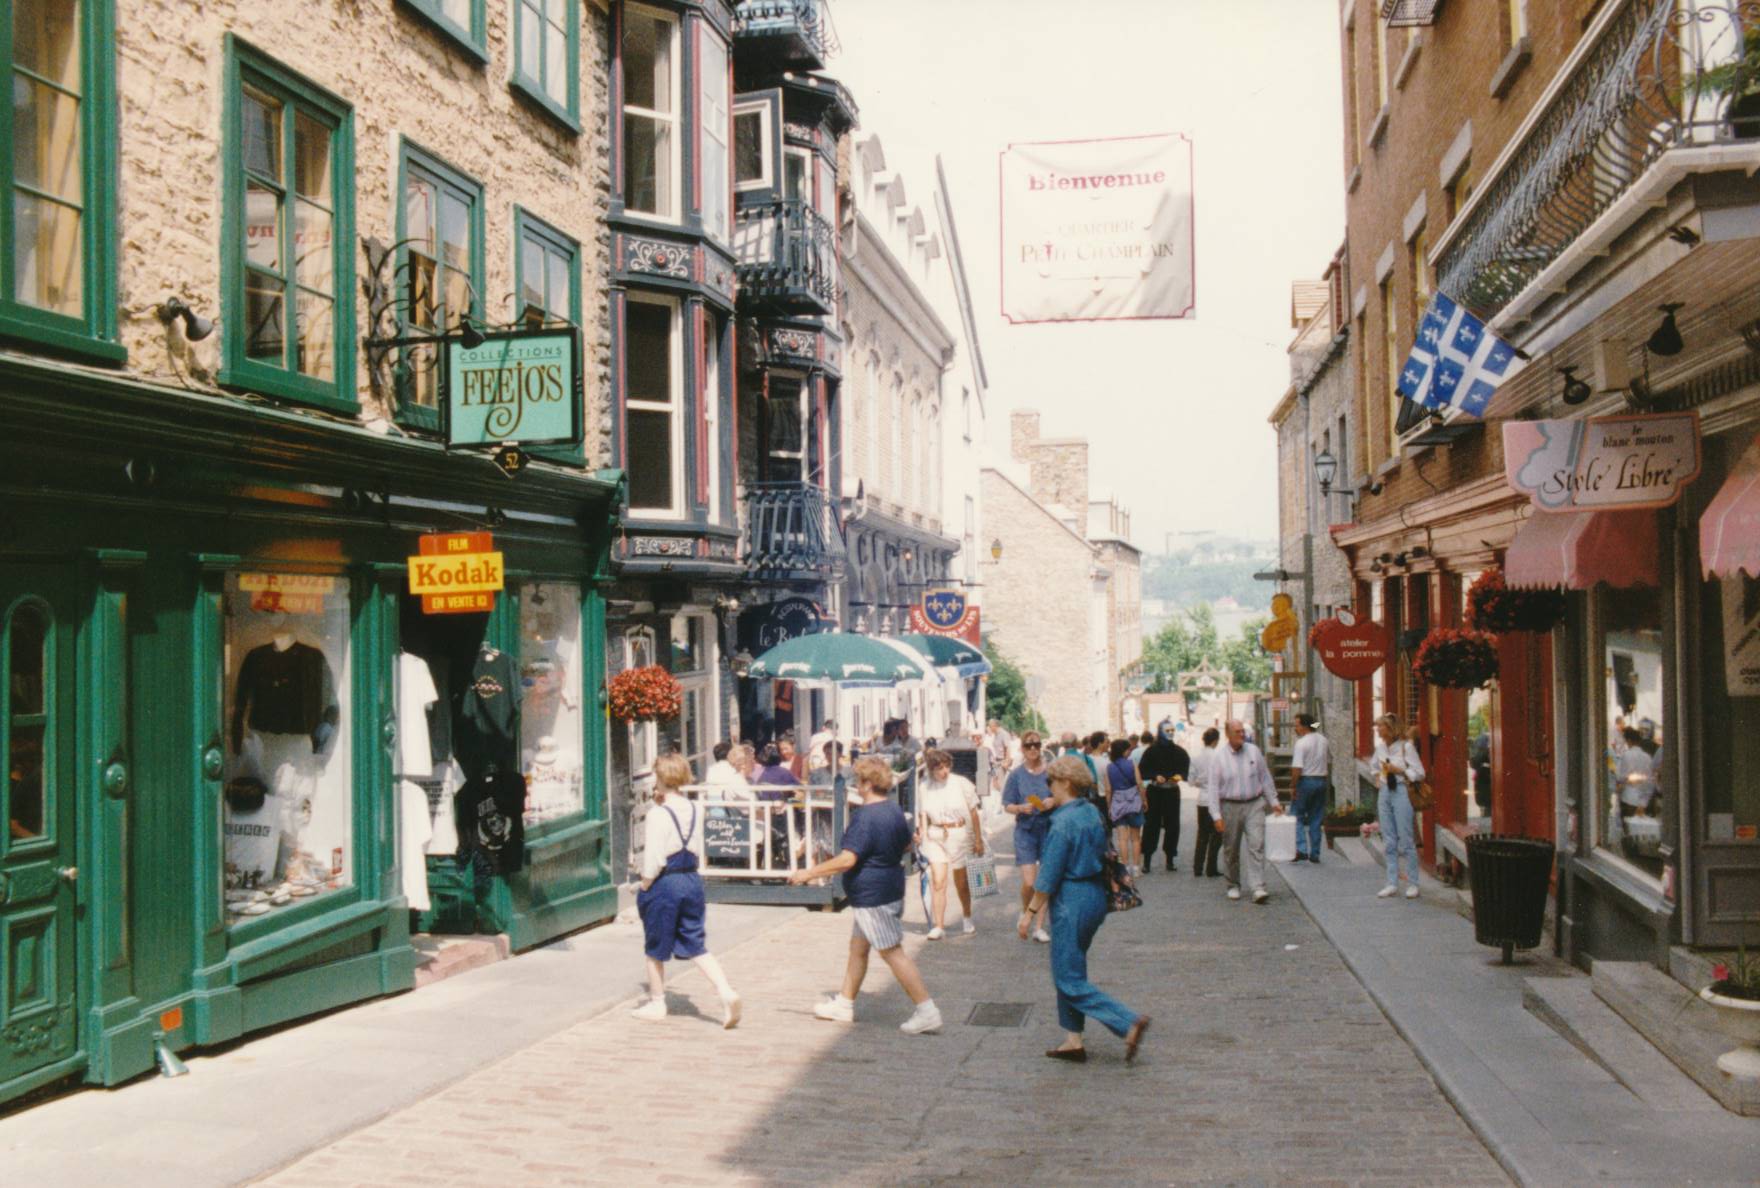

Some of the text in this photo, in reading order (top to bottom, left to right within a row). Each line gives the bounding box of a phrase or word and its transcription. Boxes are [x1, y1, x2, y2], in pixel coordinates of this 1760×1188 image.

[1028, 170, 1166, 191] bienvenue
[460, 346, 563, 361] COLLECTIONS
[1632, 425, 1642, 435] le
[1602, 435, 1675, 448] blanc mouton
[505, 452, 519, 469] 52
[1542, 453, 1681, 494] Style Libre
[447, 538, 469, 552] FILM
[416, 560, 499, 587] Kodak
[432, 597, 444, 609] EN
[447, 595, 475, 609] VENTE
[1340, 639, 1369, 648] atelier
[1326, 649, 1382, 660] la pomme
